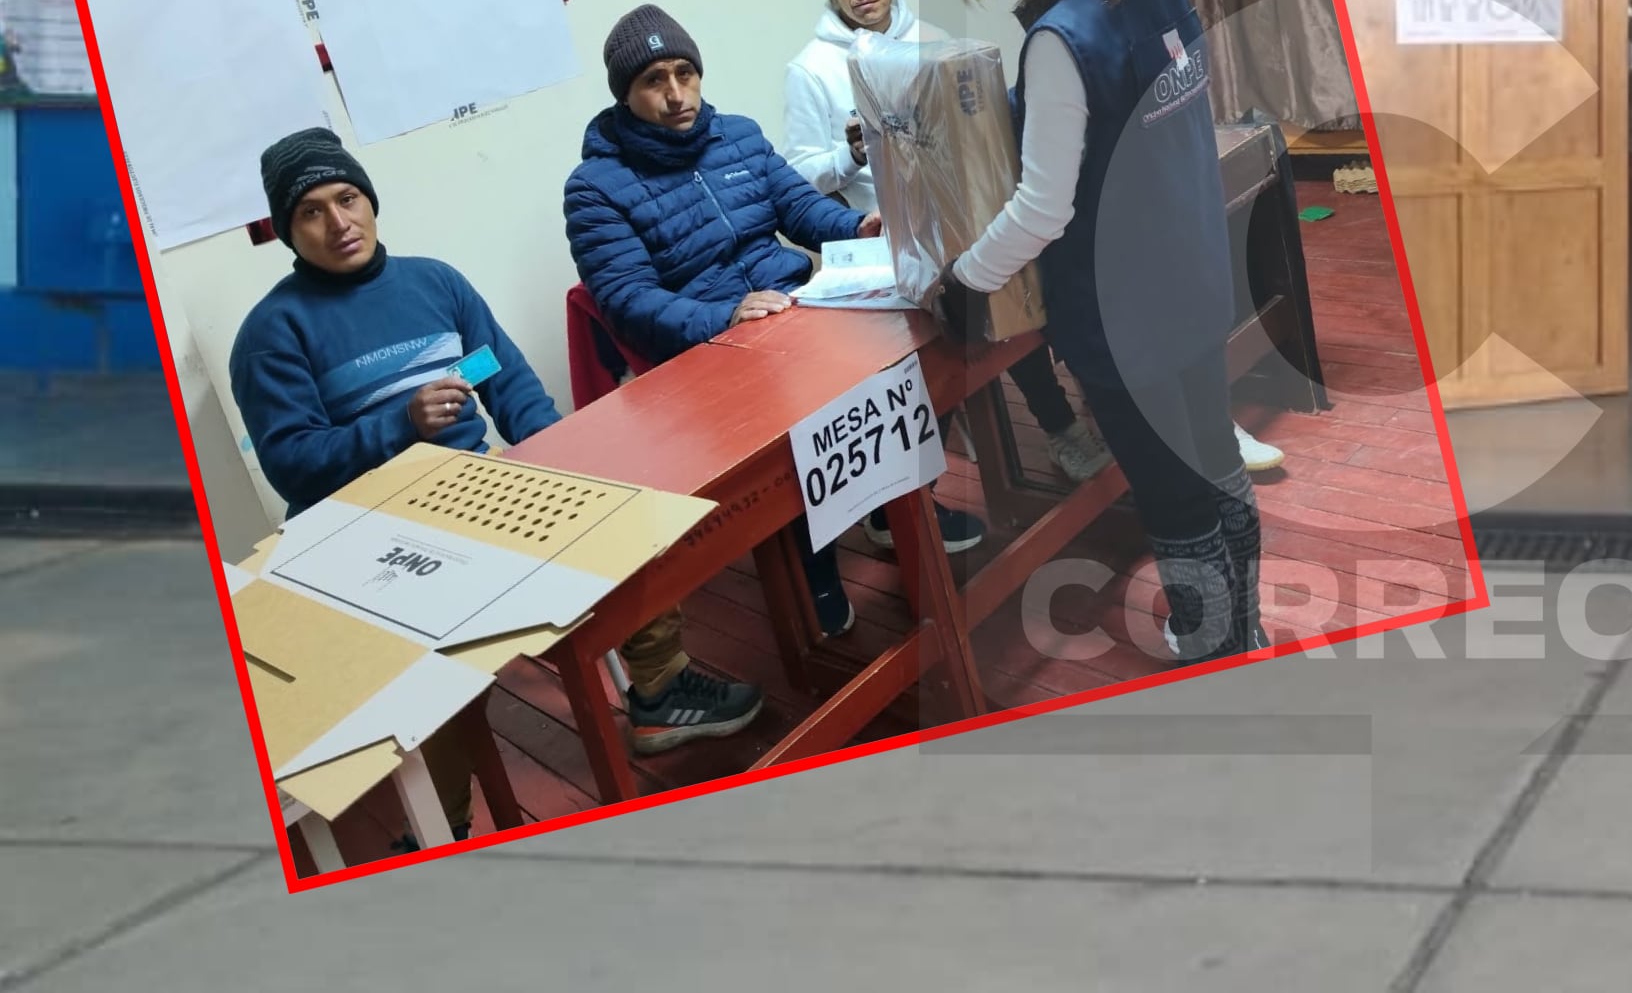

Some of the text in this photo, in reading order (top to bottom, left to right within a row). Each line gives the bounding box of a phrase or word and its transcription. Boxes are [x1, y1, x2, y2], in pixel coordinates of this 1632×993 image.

[1153, 48, 1205, 104] ONPE
[805, 403, 936, 507] 025712
[811, 397, 882, 458] MESA
[375, 546, 443, 577] ONPE
